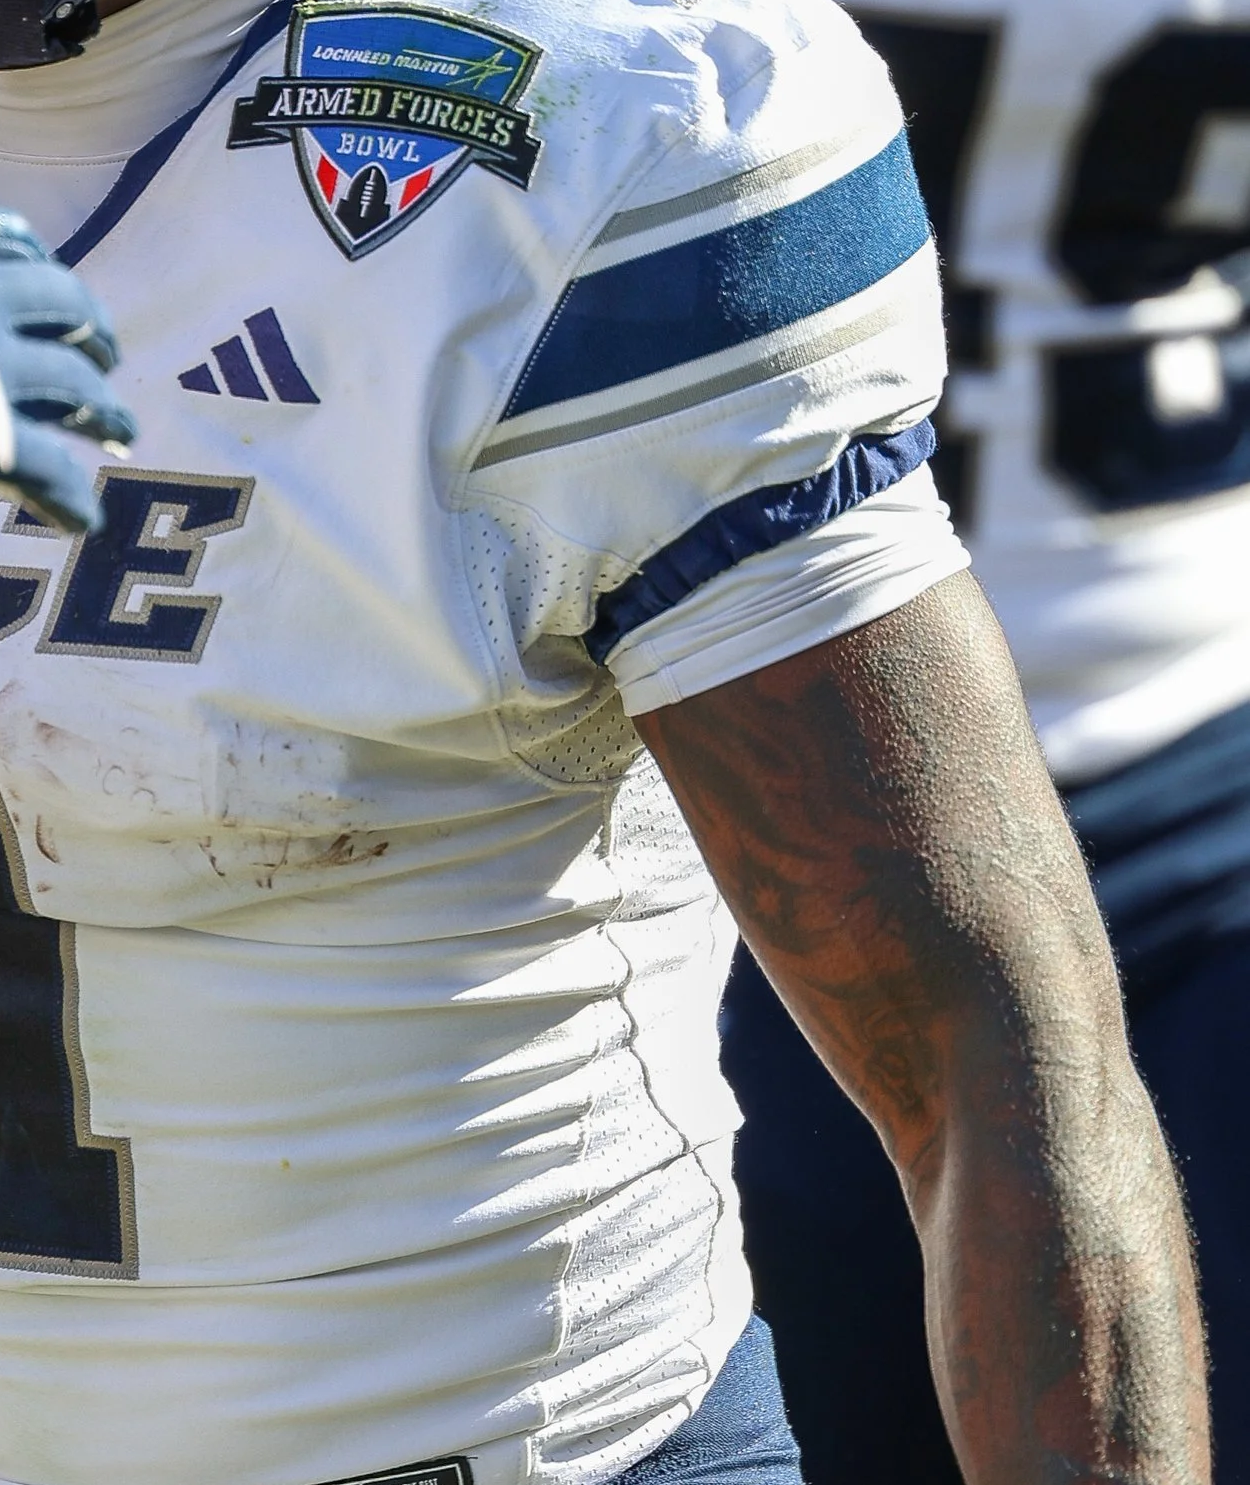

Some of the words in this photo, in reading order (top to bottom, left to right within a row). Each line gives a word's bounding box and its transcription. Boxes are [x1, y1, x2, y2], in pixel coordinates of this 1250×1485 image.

[312, 45, 391, 67] LOCKHEED
[392, 55, 461, 76] MARTIN
[268, 86, 382, 117] ARMED
[387, 90, 515, 147] FORCES
[336, 132, 421, 163] BOWL
